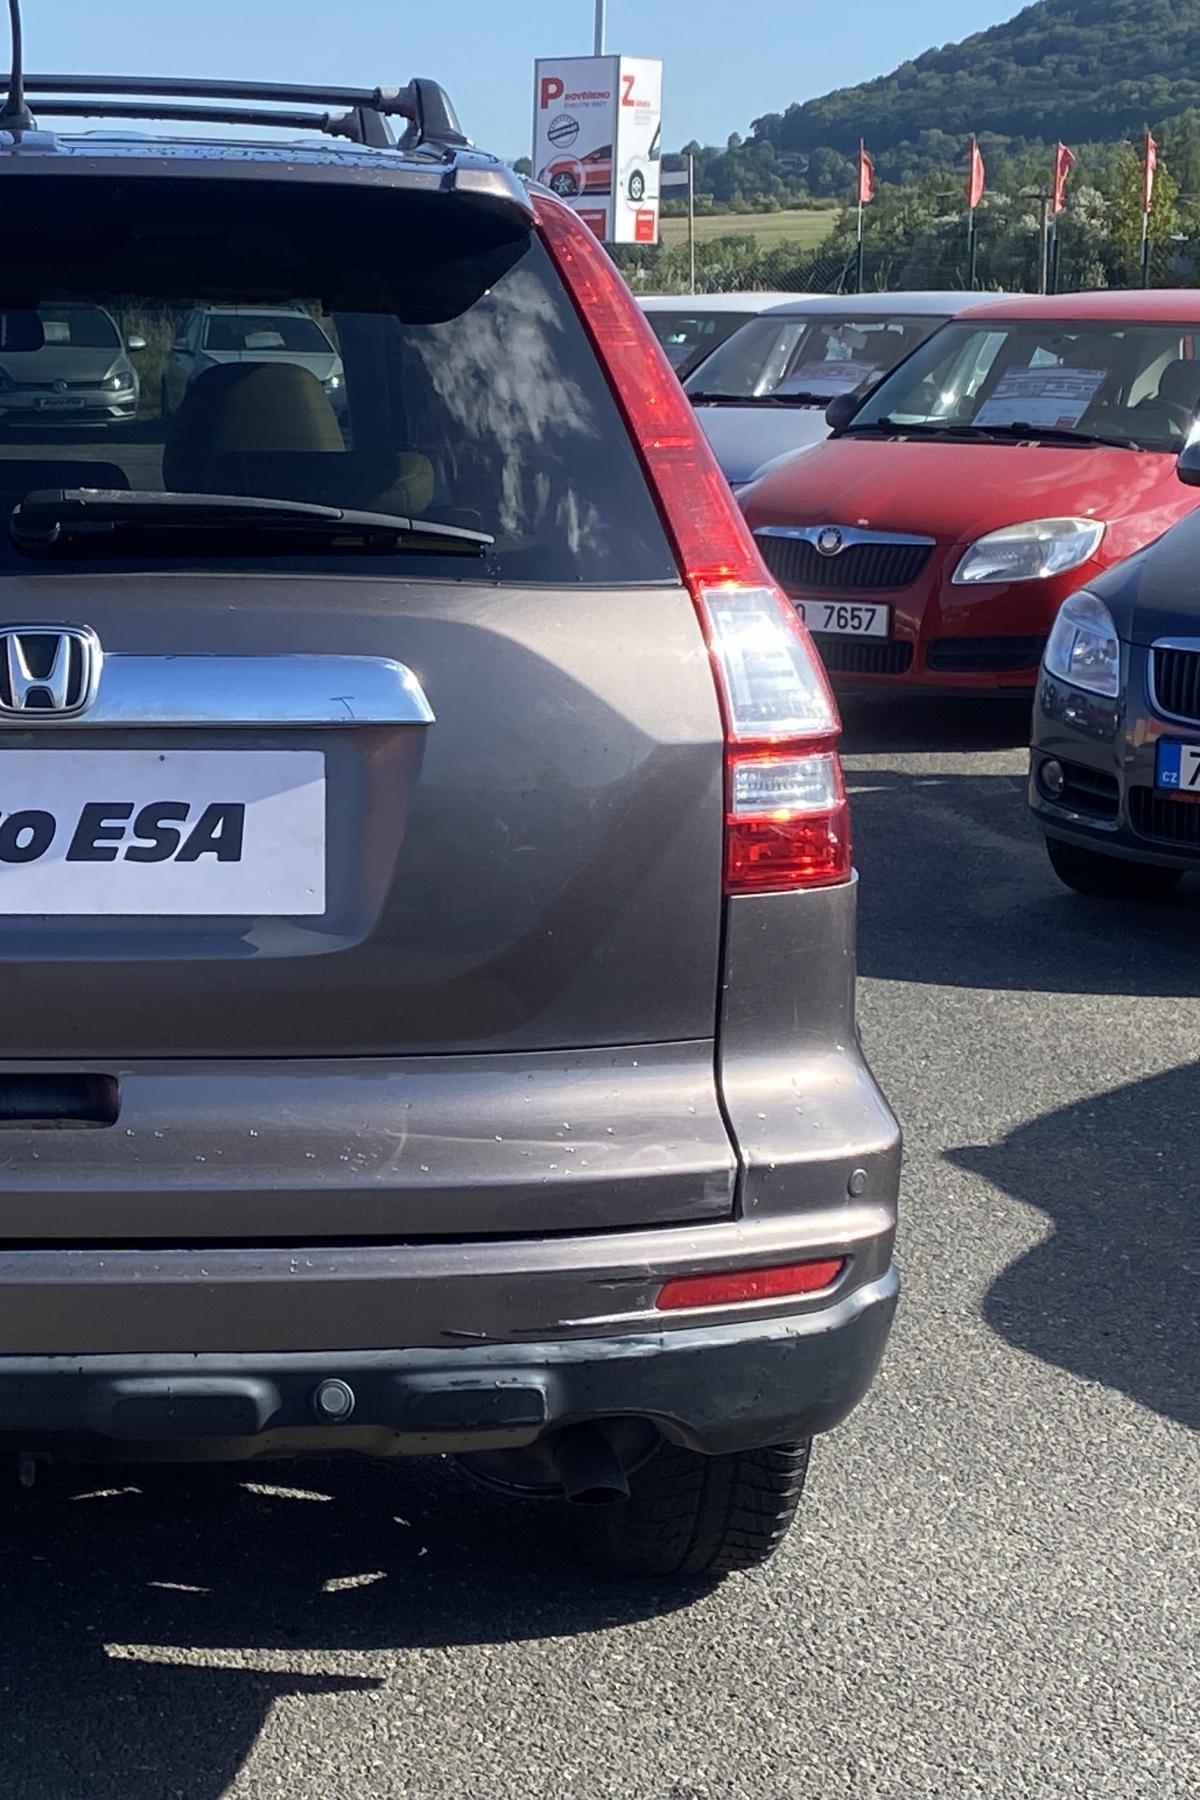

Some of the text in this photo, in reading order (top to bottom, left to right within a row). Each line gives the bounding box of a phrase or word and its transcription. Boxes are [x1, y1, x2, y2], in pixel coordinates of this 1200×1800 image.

[823, 604, 877, 632] 7657
[1162, 771, 1178, 783] CZ
[65, 801, 246, 862] ESA
